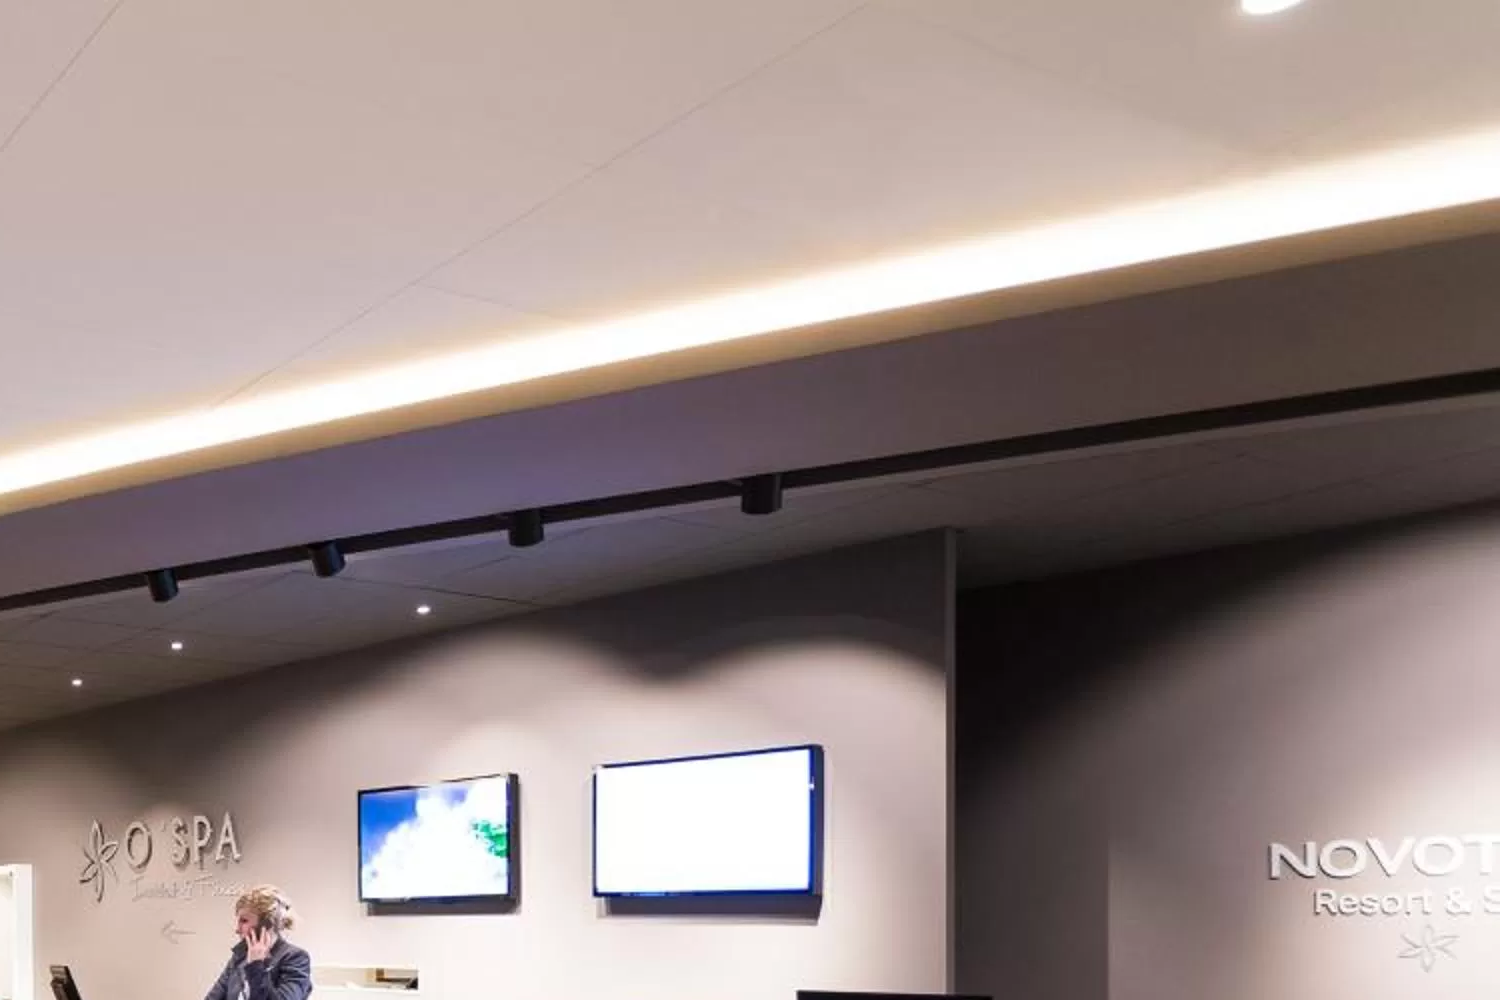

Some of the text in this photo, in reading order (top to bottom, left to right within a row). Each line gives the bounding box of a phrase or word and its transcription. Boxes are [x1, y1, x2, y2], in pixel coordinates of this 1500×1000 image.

[171, 811, 242, 869] SPA
[1267, 834, 1500, 881] NOVOT
[1313, 886, 1433, 917] Resort
[1444, 886, 1473, 917] &
